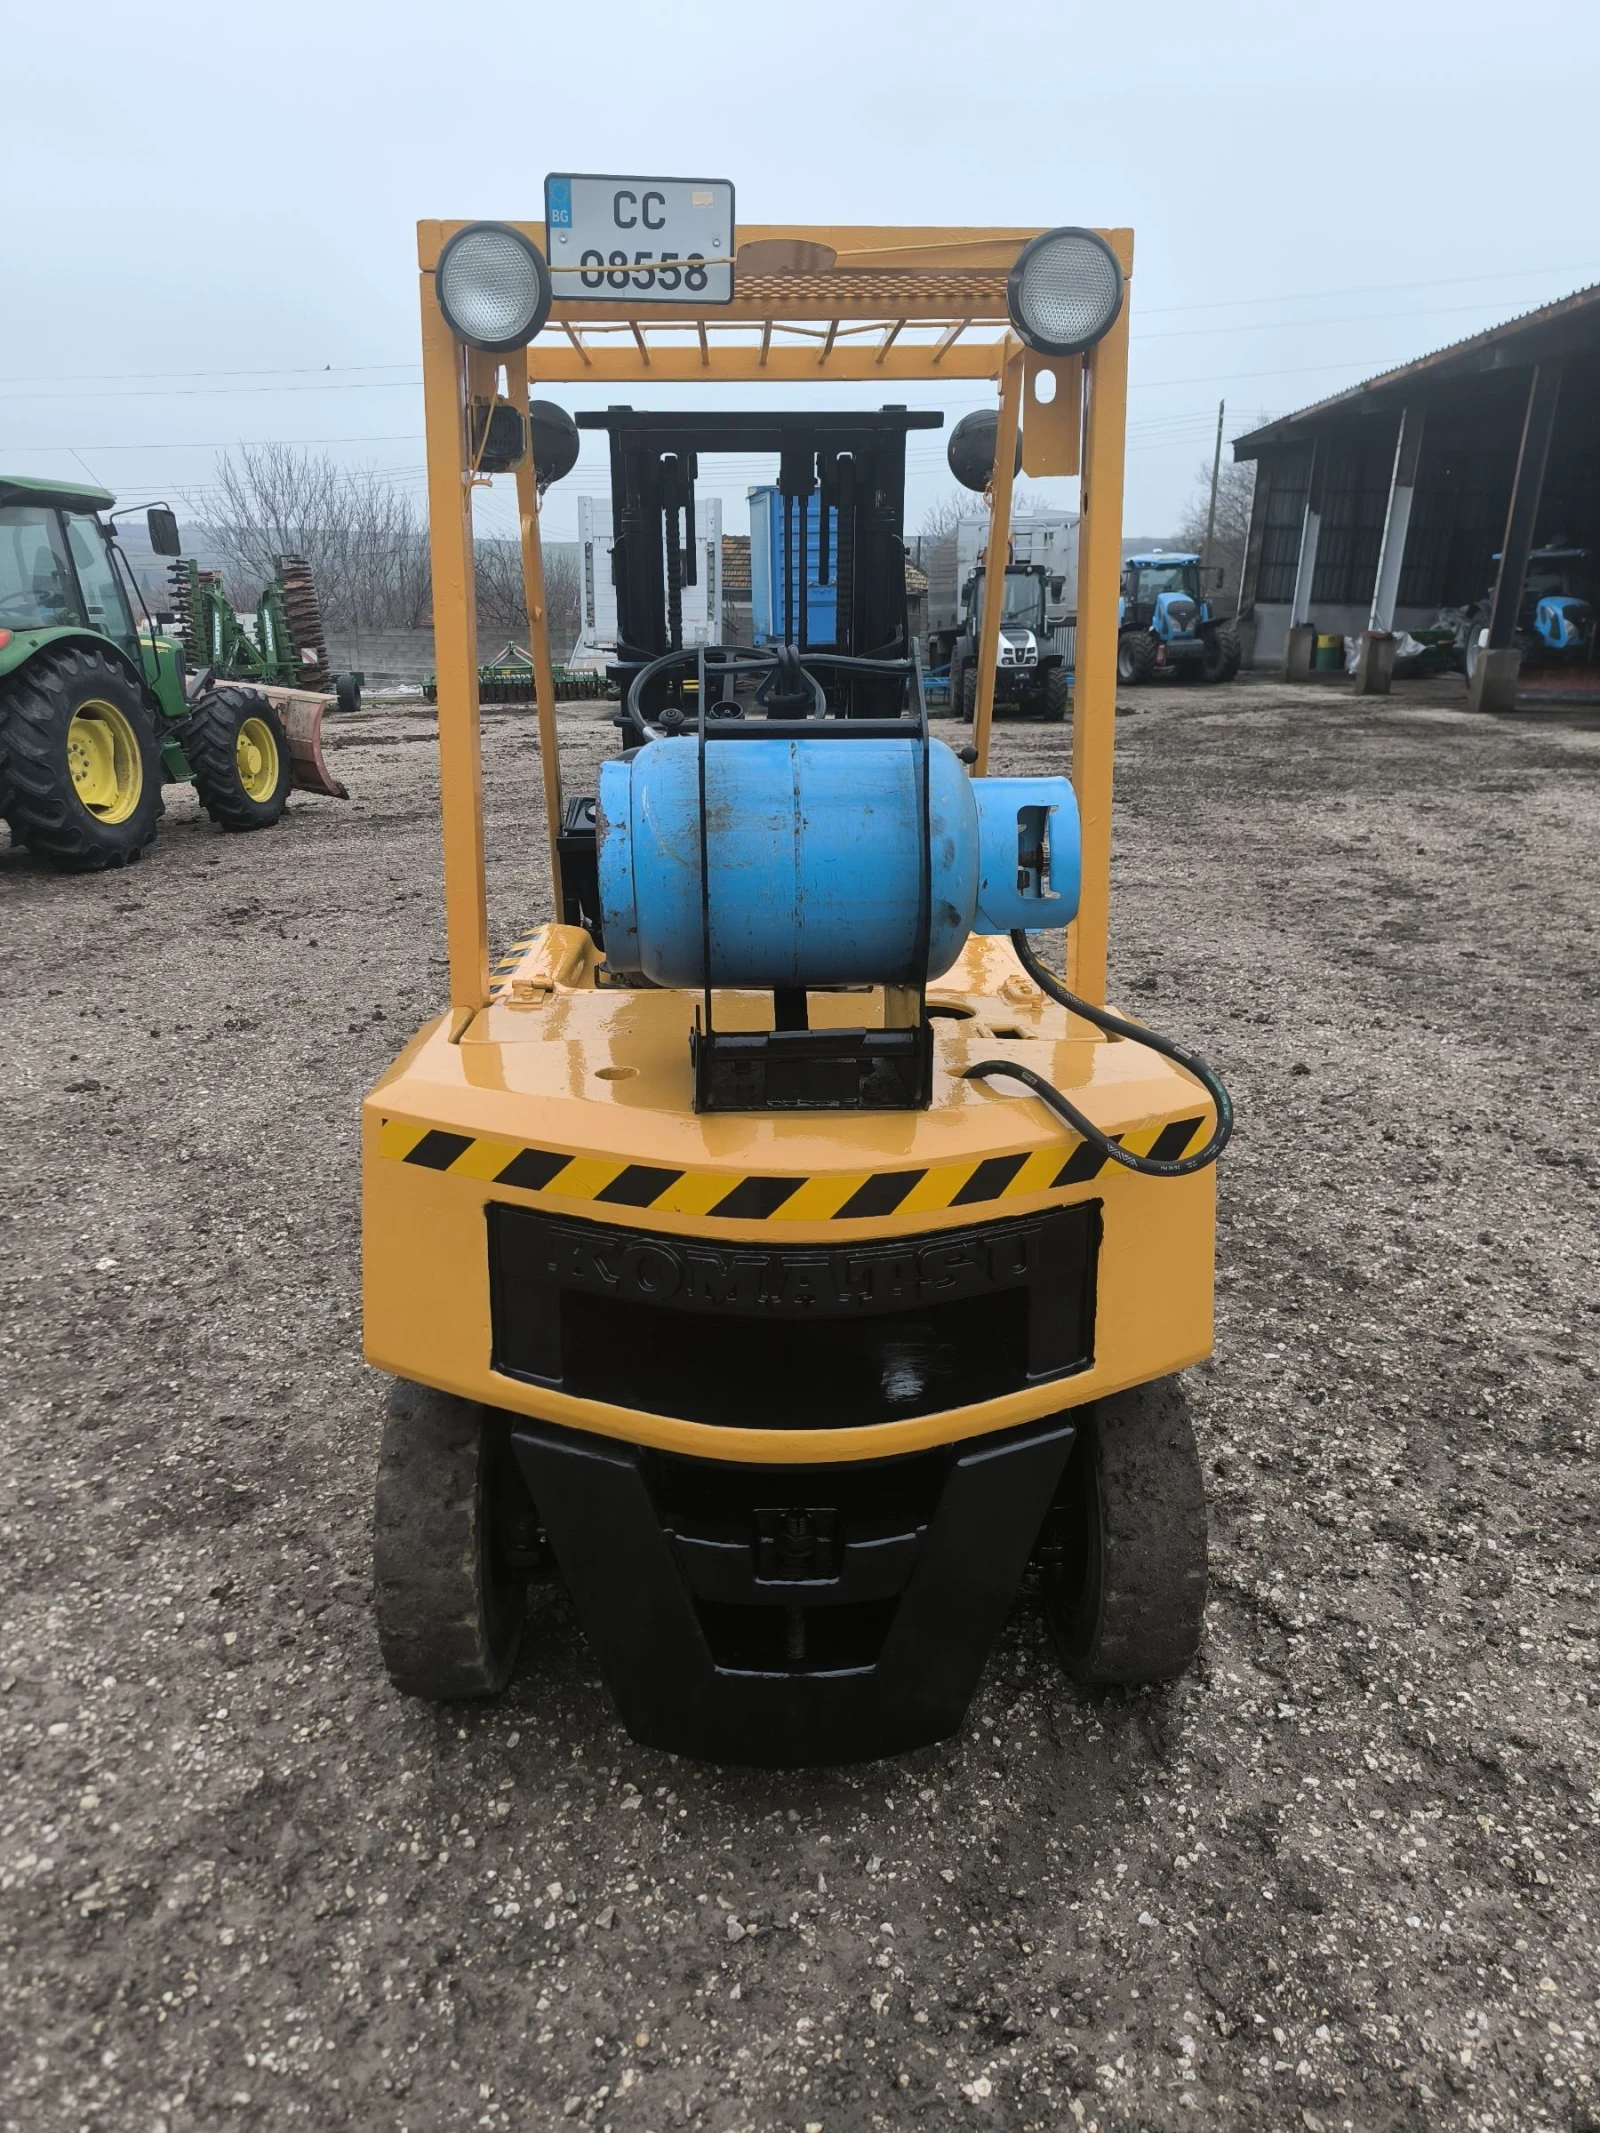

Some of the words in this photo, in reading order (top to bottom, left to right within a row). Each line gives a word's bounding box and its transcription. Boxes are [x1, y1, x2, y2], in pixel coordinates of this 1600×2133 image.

[552, 209, 569, 222] BG
[613, 190, 666, 230] CC
[580, 249, 708, 292] 08558
[263, 608, 274, 652] AMAZONE
[546, 1221, 1043, 1305] KOMATSU
